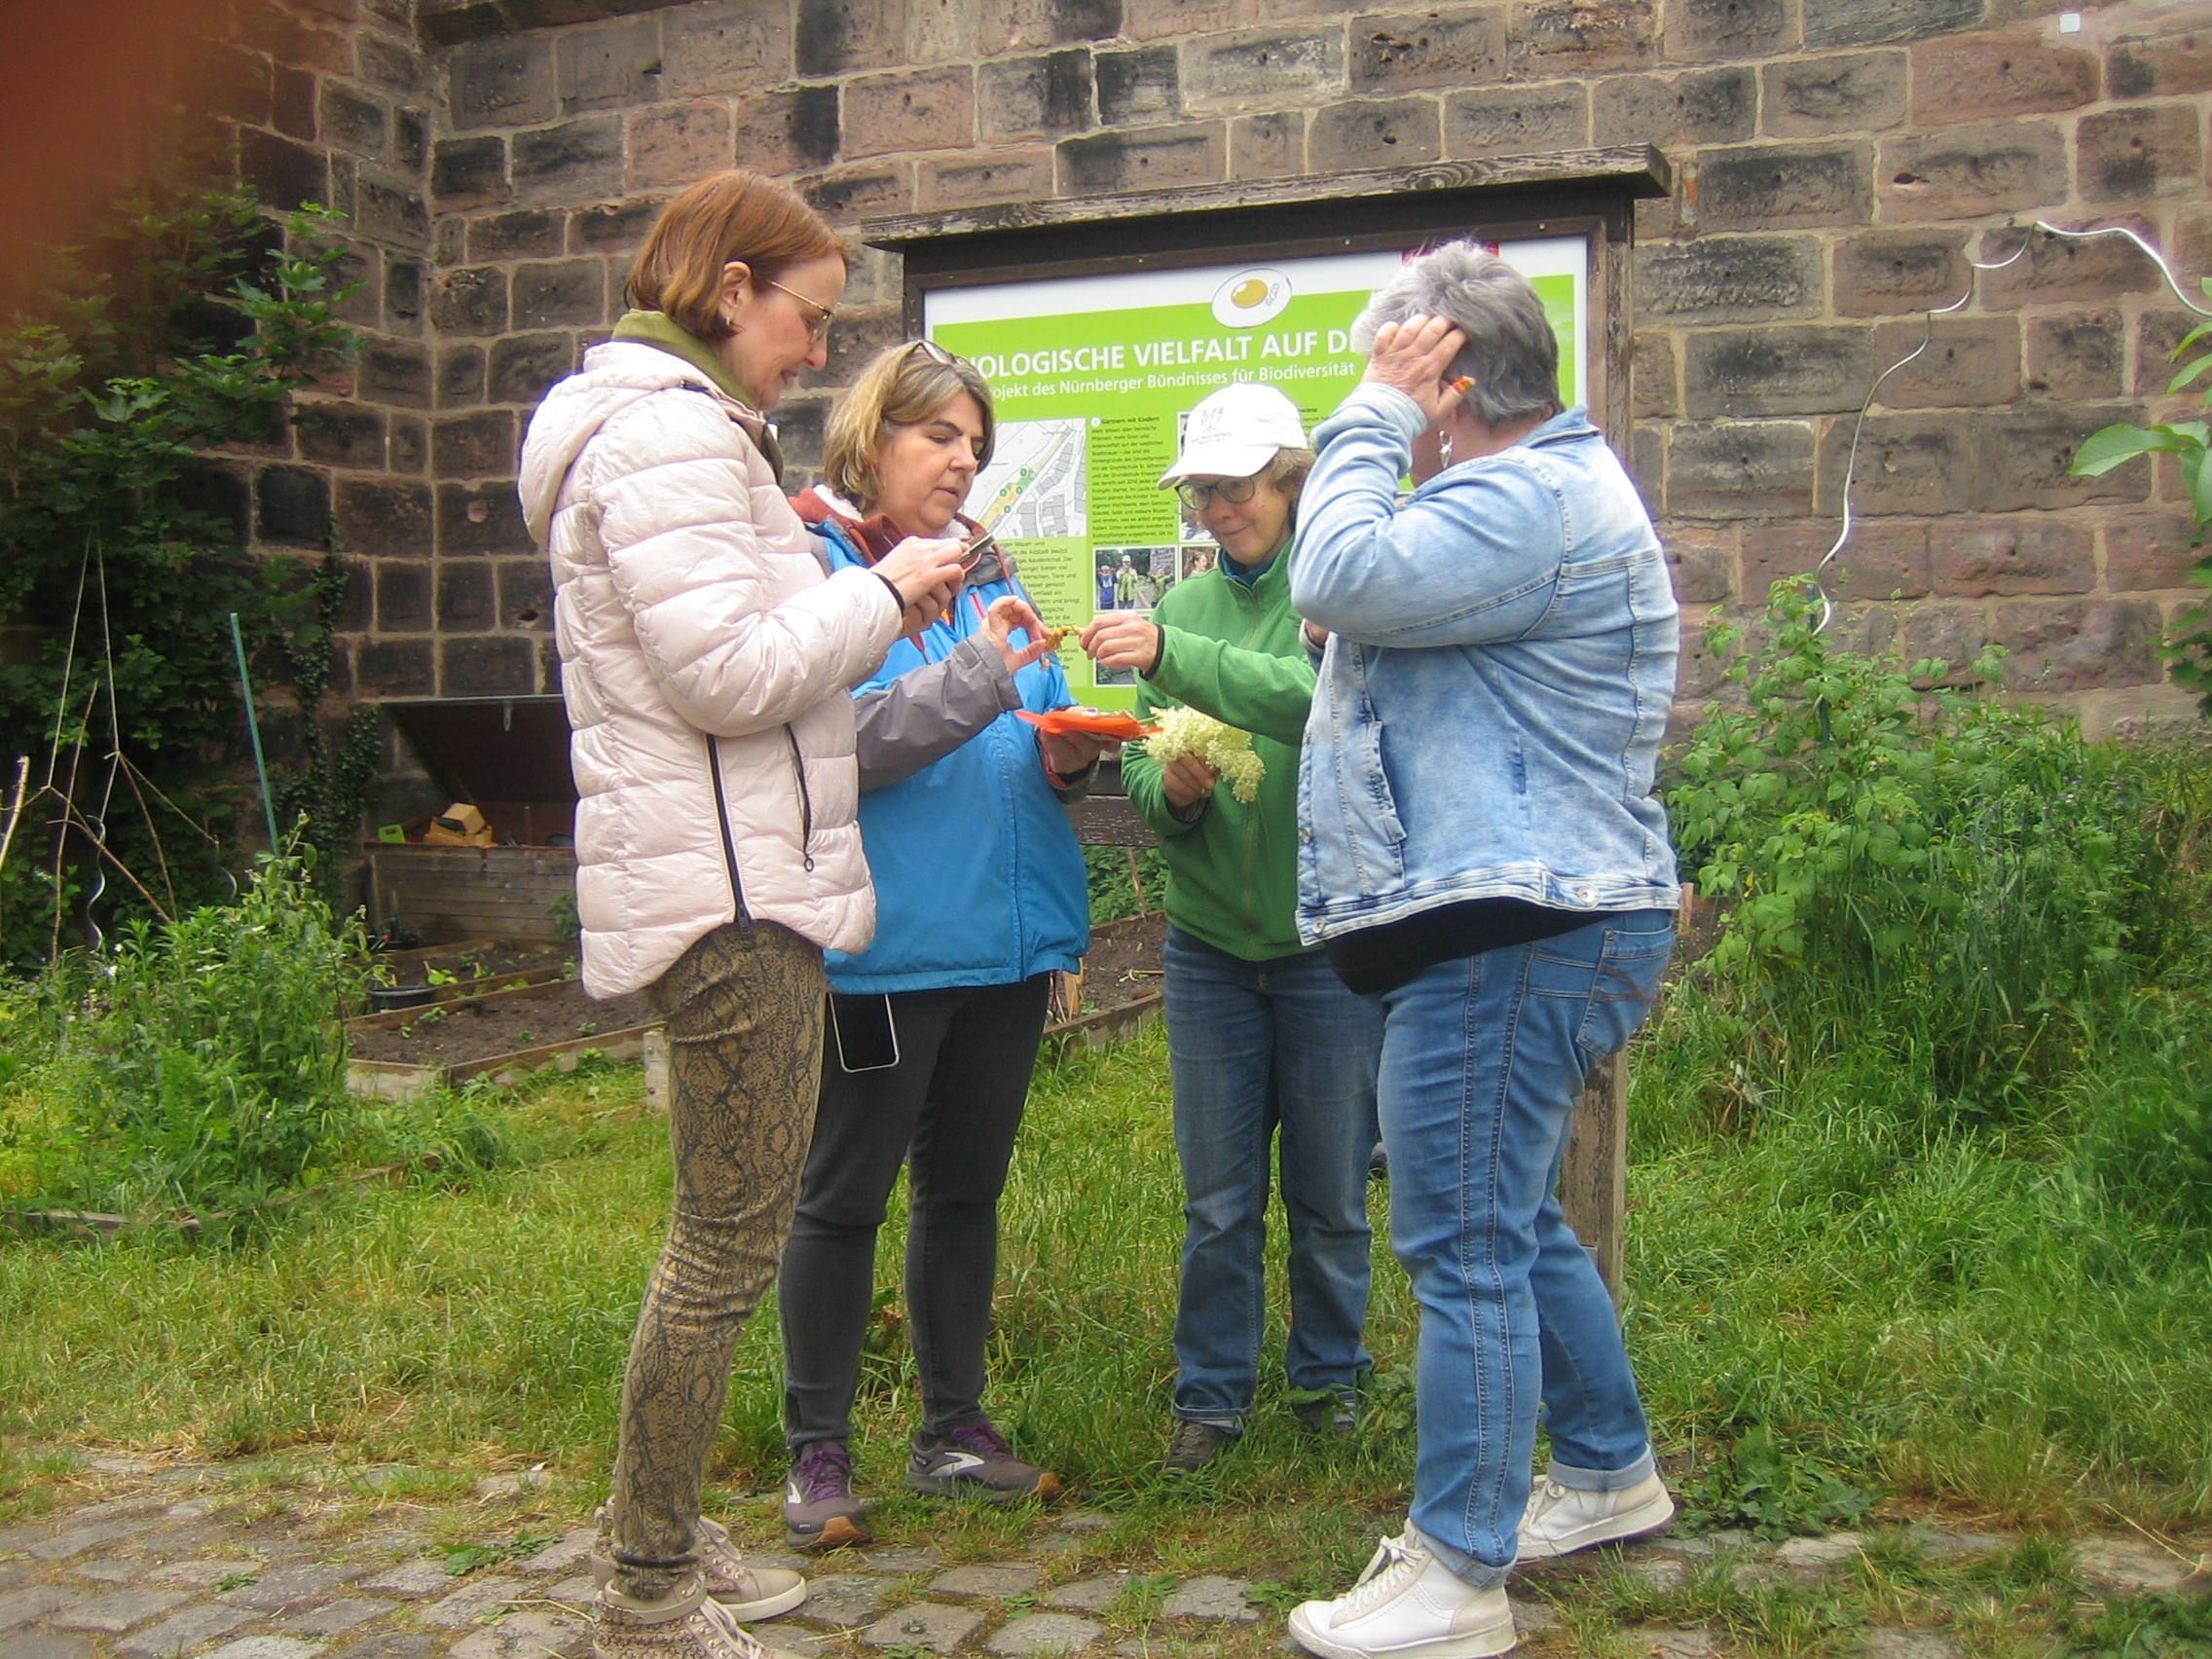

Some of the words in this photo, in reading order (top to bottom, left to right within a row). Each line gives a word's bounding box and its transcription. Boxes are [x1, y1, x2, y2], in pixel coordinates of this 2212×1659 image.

[1133, 335, 1253, 367] VIELFALT
[1261, 331, 1318, 359] AUF
[991, 383, 1029, 401] ojekt
[1032, 381, 1056, 397] des
[1059, 376, 1143, 394] Nürnberger
[1148, 370, 1228, 389] Bündnisses
[1232, 367, 1254, 384] für
[1259, 361, 1356, 382] Biodiversität
